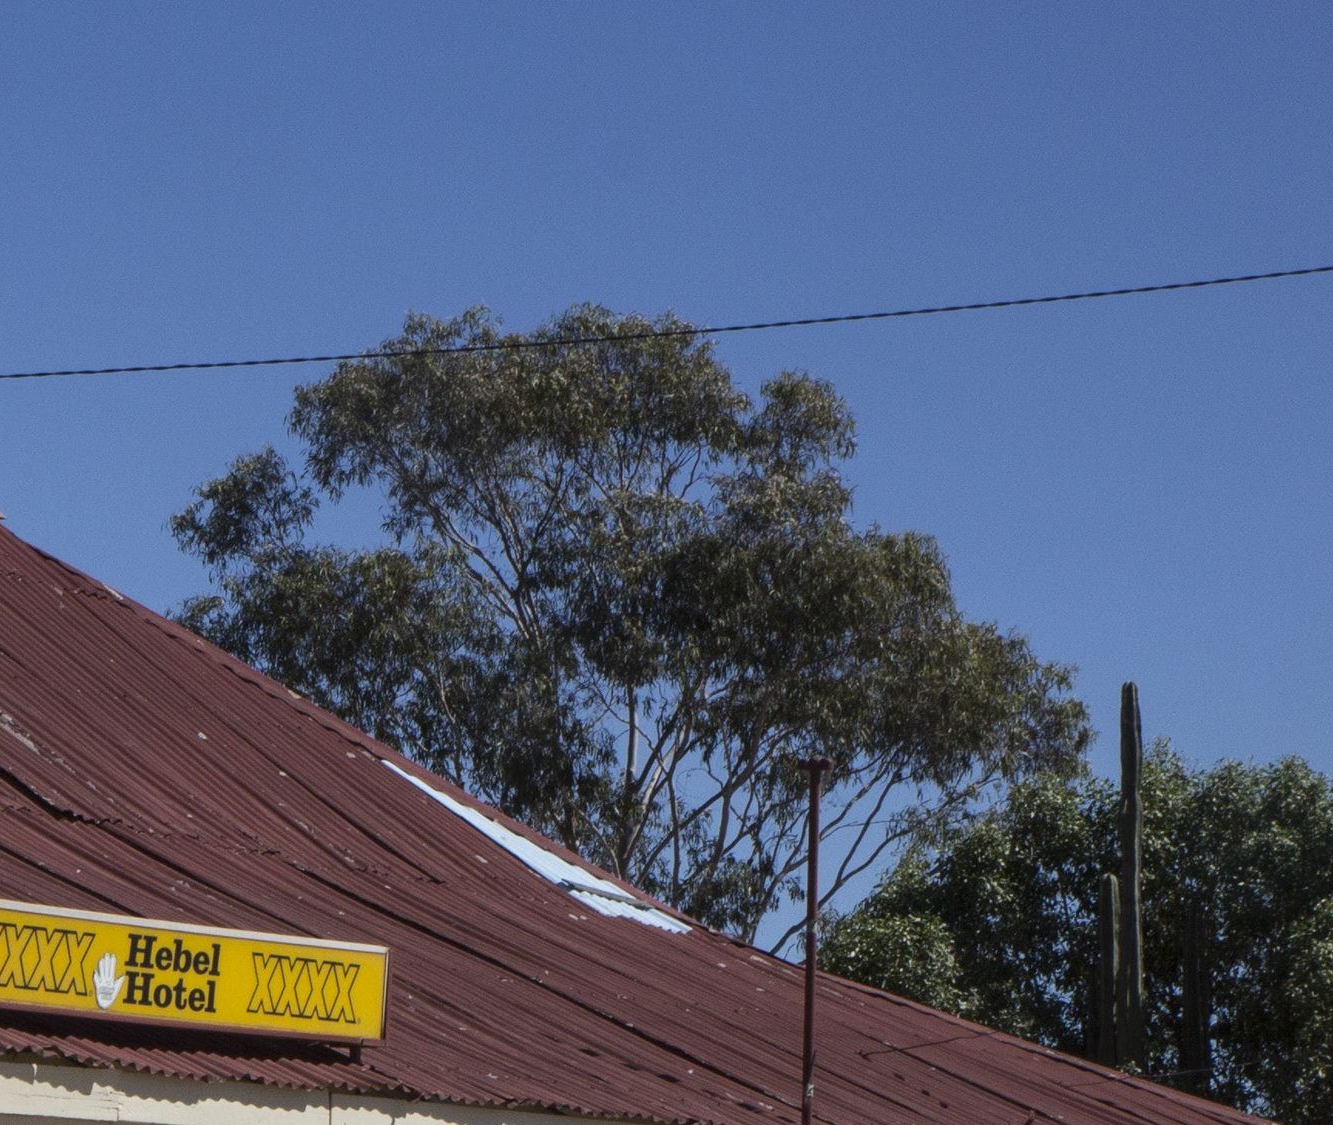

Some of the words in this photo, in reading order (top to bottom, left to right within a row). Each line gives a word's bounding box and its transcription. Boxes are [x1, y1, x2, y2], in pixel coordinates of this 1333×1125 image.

[124, 933, 221, 977] Hebel
[123, 970, 217, 1013] Hotel
[246, 952, 361, 1024] XXXX
